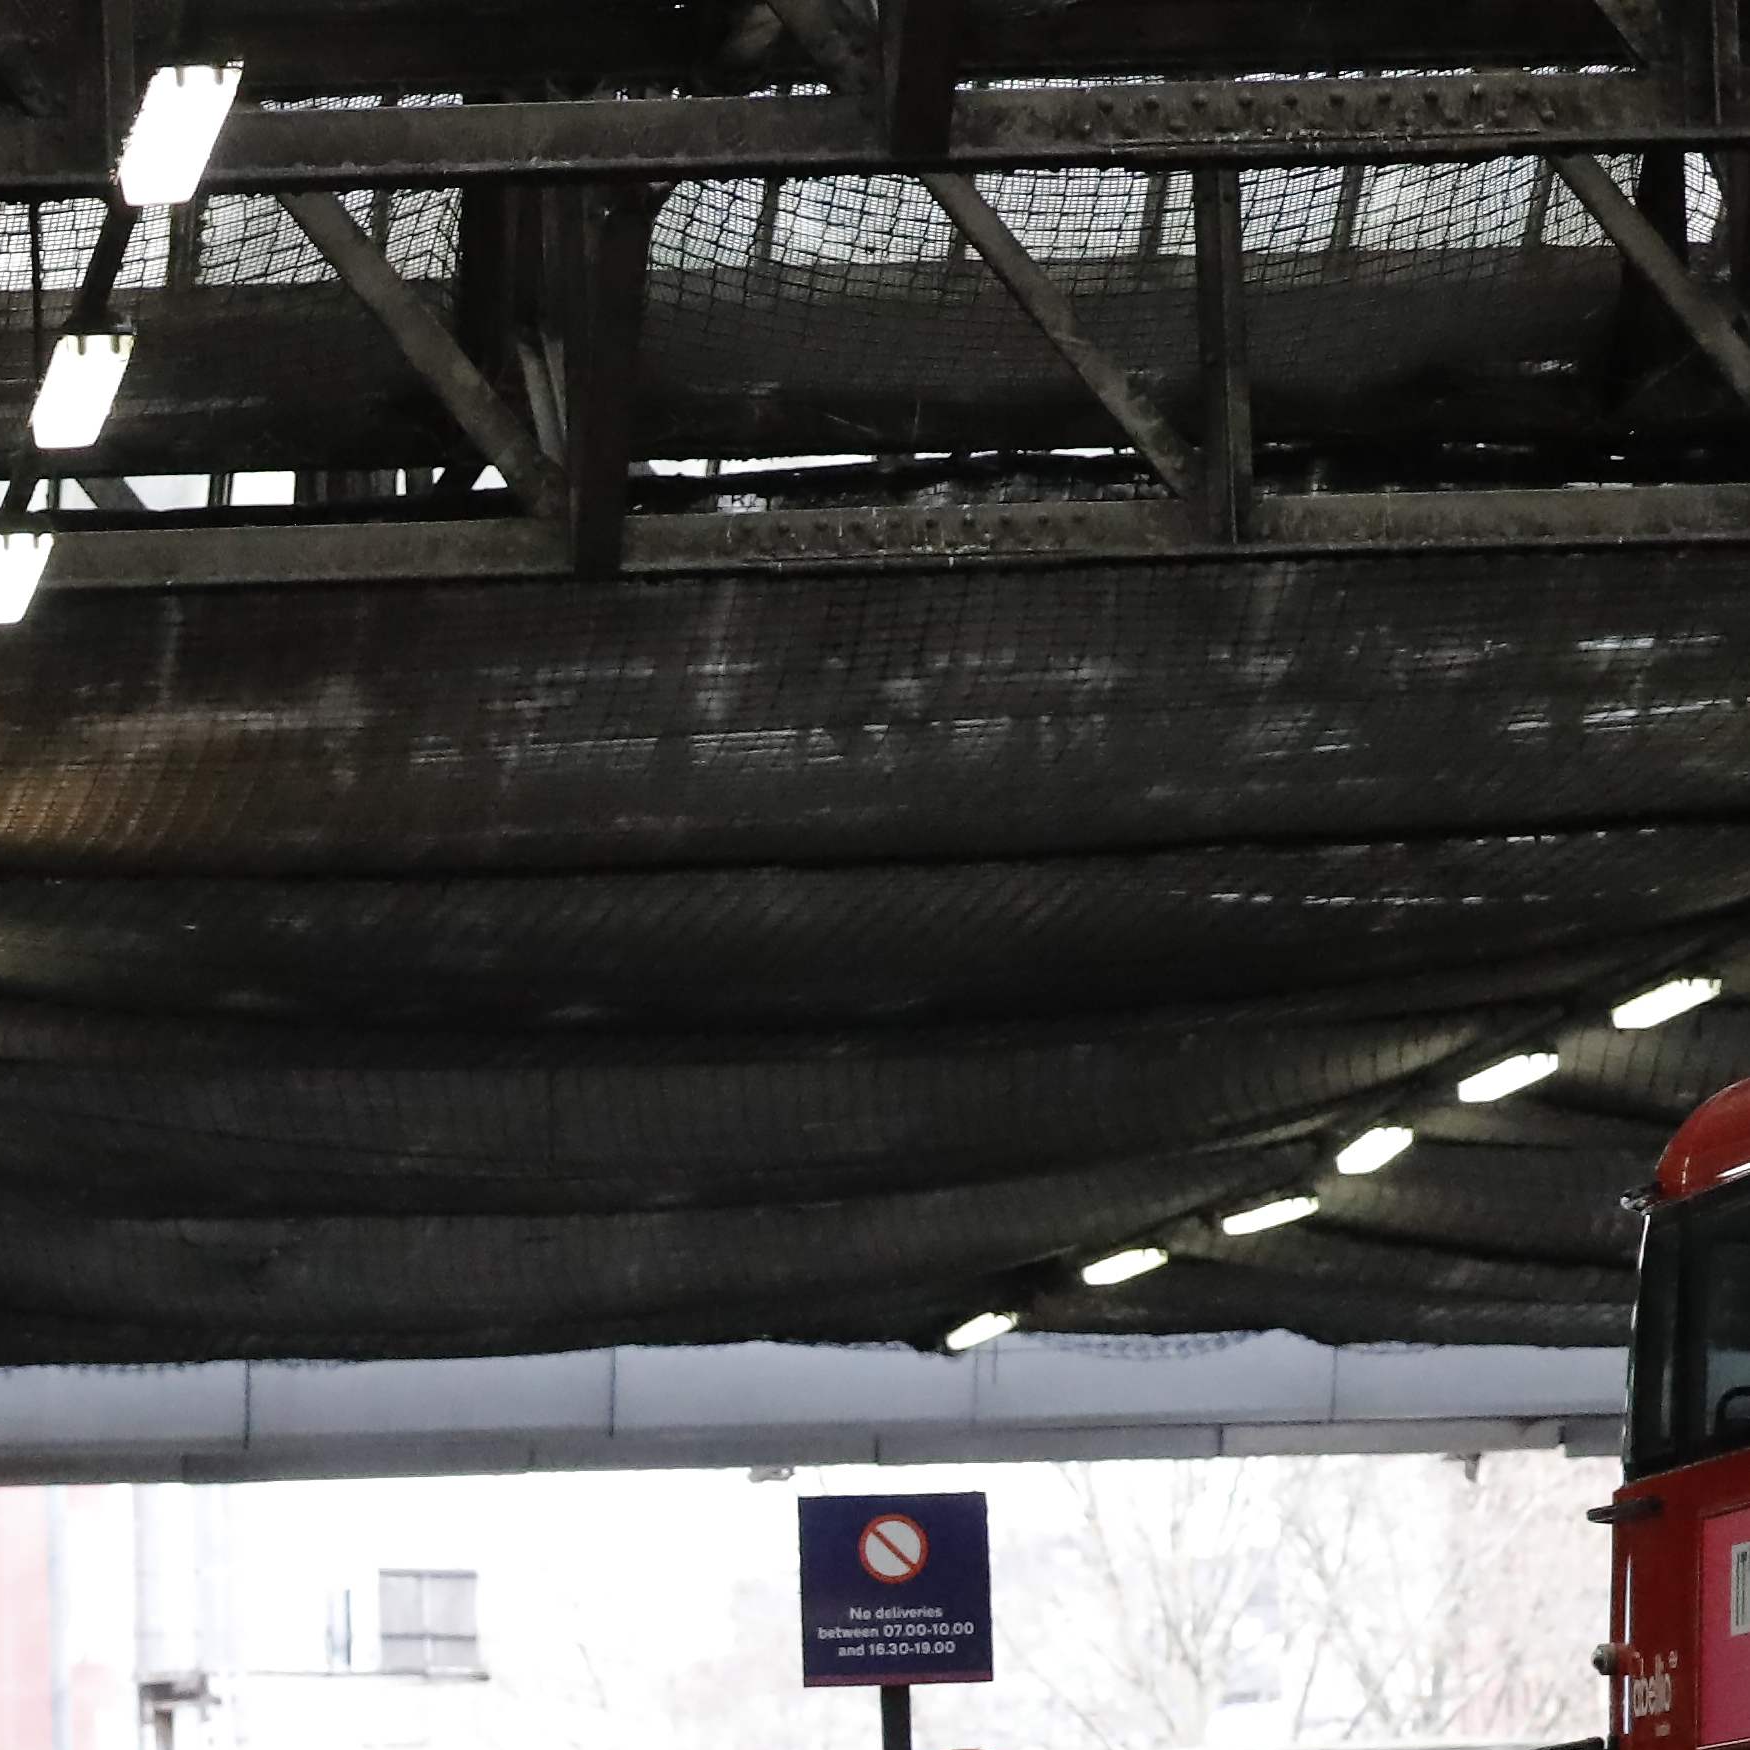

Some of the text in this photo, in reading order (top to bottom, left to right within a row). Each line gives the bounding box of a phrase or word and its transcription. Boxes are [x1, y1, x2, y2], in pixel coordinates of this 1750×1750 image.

[850, 1606, 943, 1620] No deliveries
[818, 1622, 974, 1640] between 07.00-10.00
[838, 1641, 956, 1656] and 16.30-19.00
